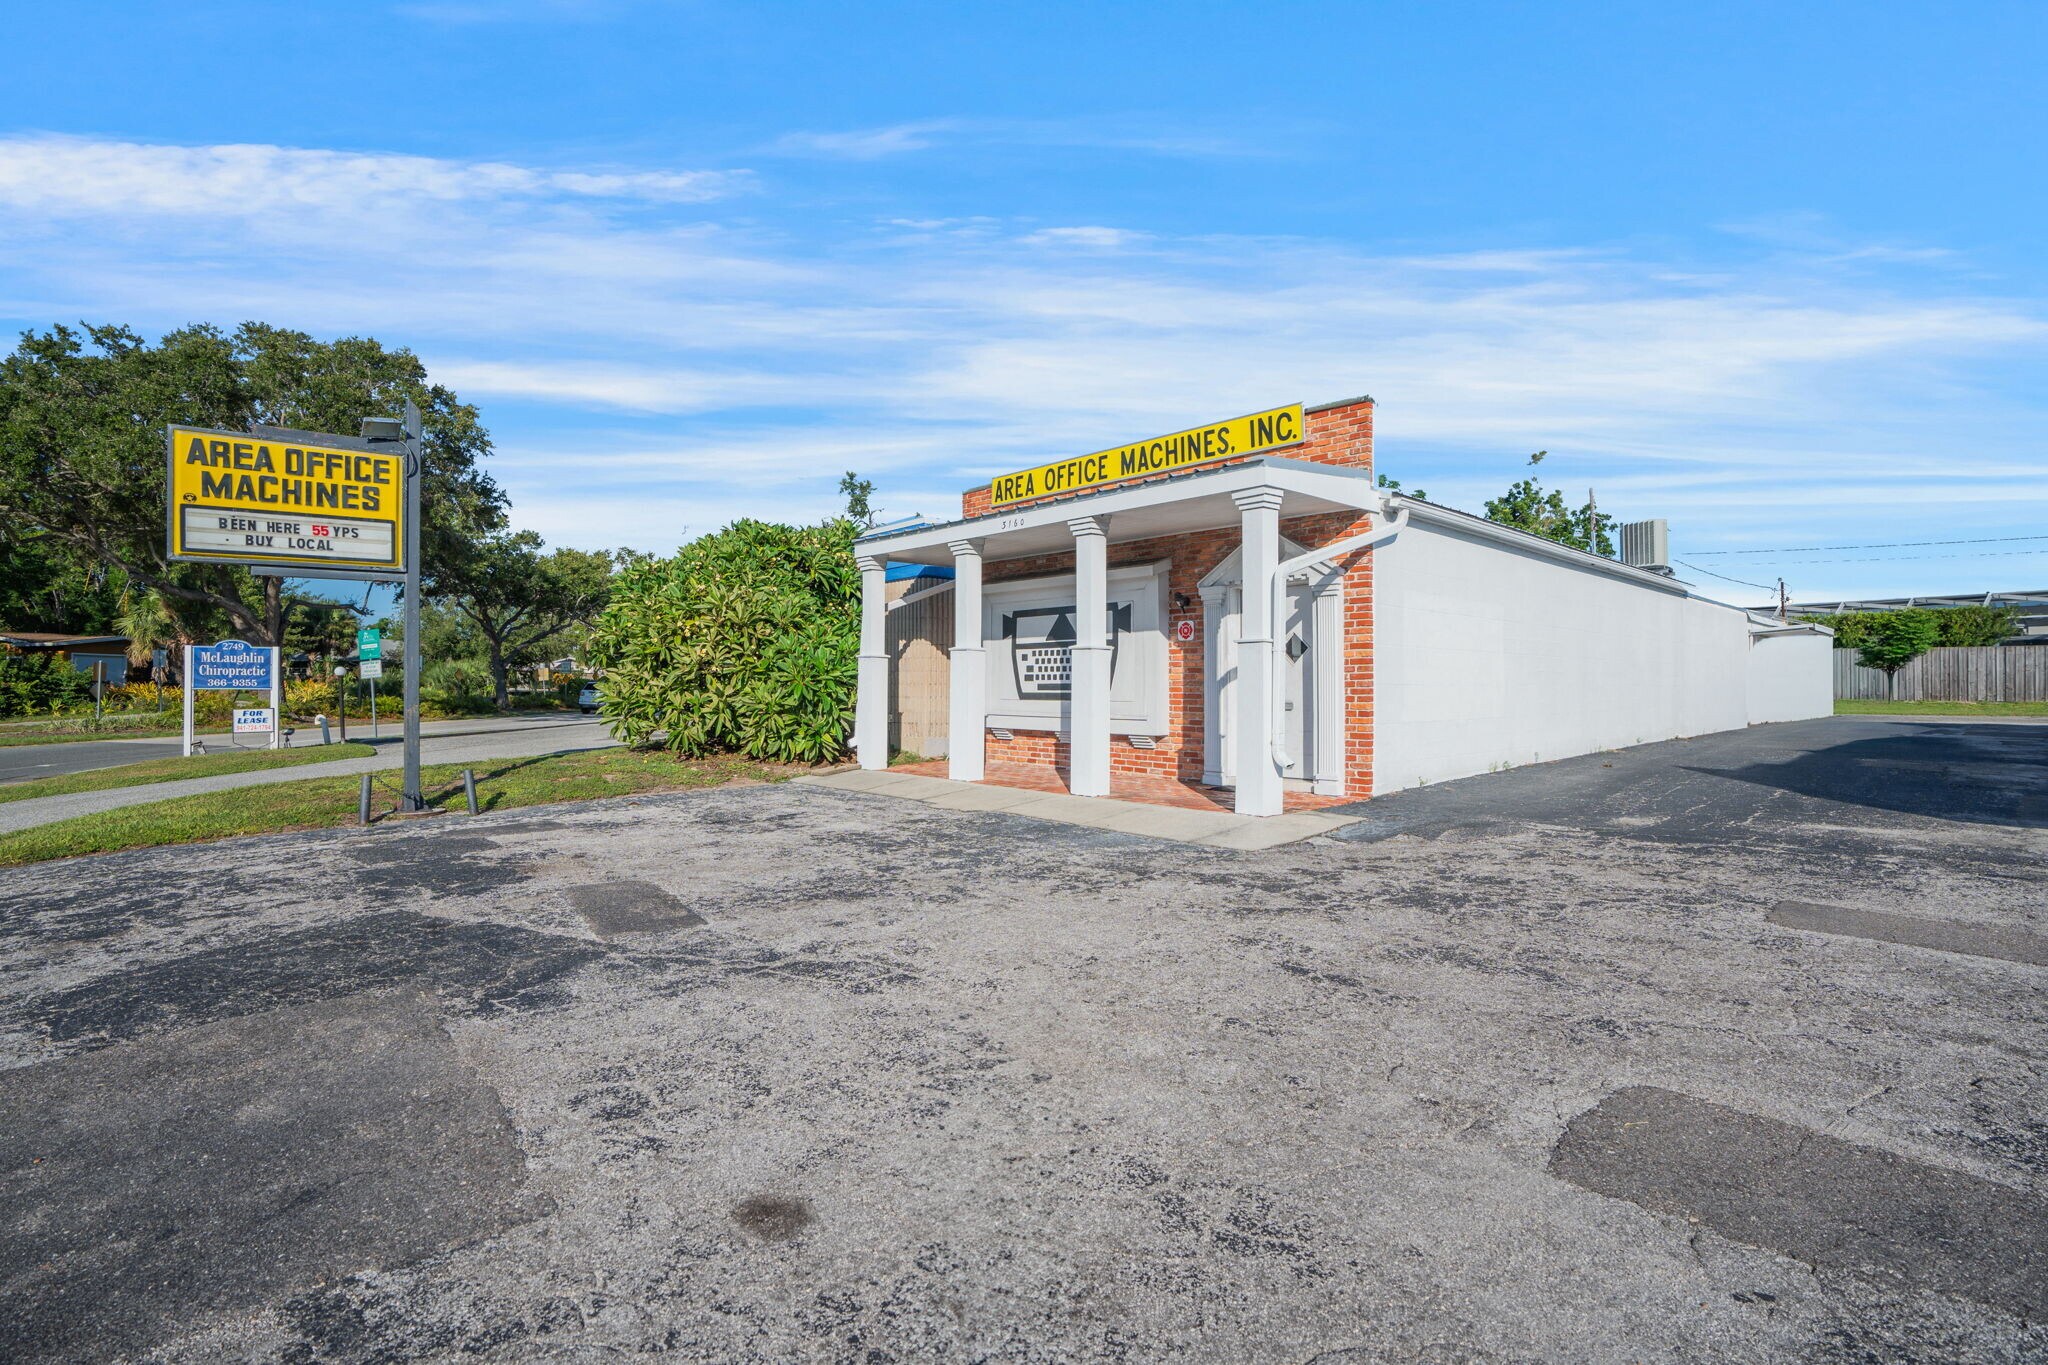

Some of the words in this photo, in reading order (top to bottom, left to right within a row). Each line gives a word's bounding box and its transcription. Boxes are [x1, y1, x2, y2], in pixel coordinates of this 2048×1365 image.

[186, 438, 276, 473] AREA
[285, 448, 391, 485] OFFICE
[994, 472, 1034, 503] AREA
[1045, 454, 1108, 491] OFFICE
[1120, 426, 1236, 476] MACHINES,
[1249, 412, 1298, 448] INC.
[201, 470, 380, 511] MACHINES
[219, 517, 257, 532] BEEN
[267, 521, 300, 535] HERE
[312, 524, 329, 537] 55
[245, 535, 273, 547] BUY
[288, 537, 335, 551] LOCAL
[222, 642, 244, 650] 2749
[201, 652, 264, 665] McLaughlin
[199, 665, 266, 678] Chiropractic
[207, 679, 257, 687] 366-9355
